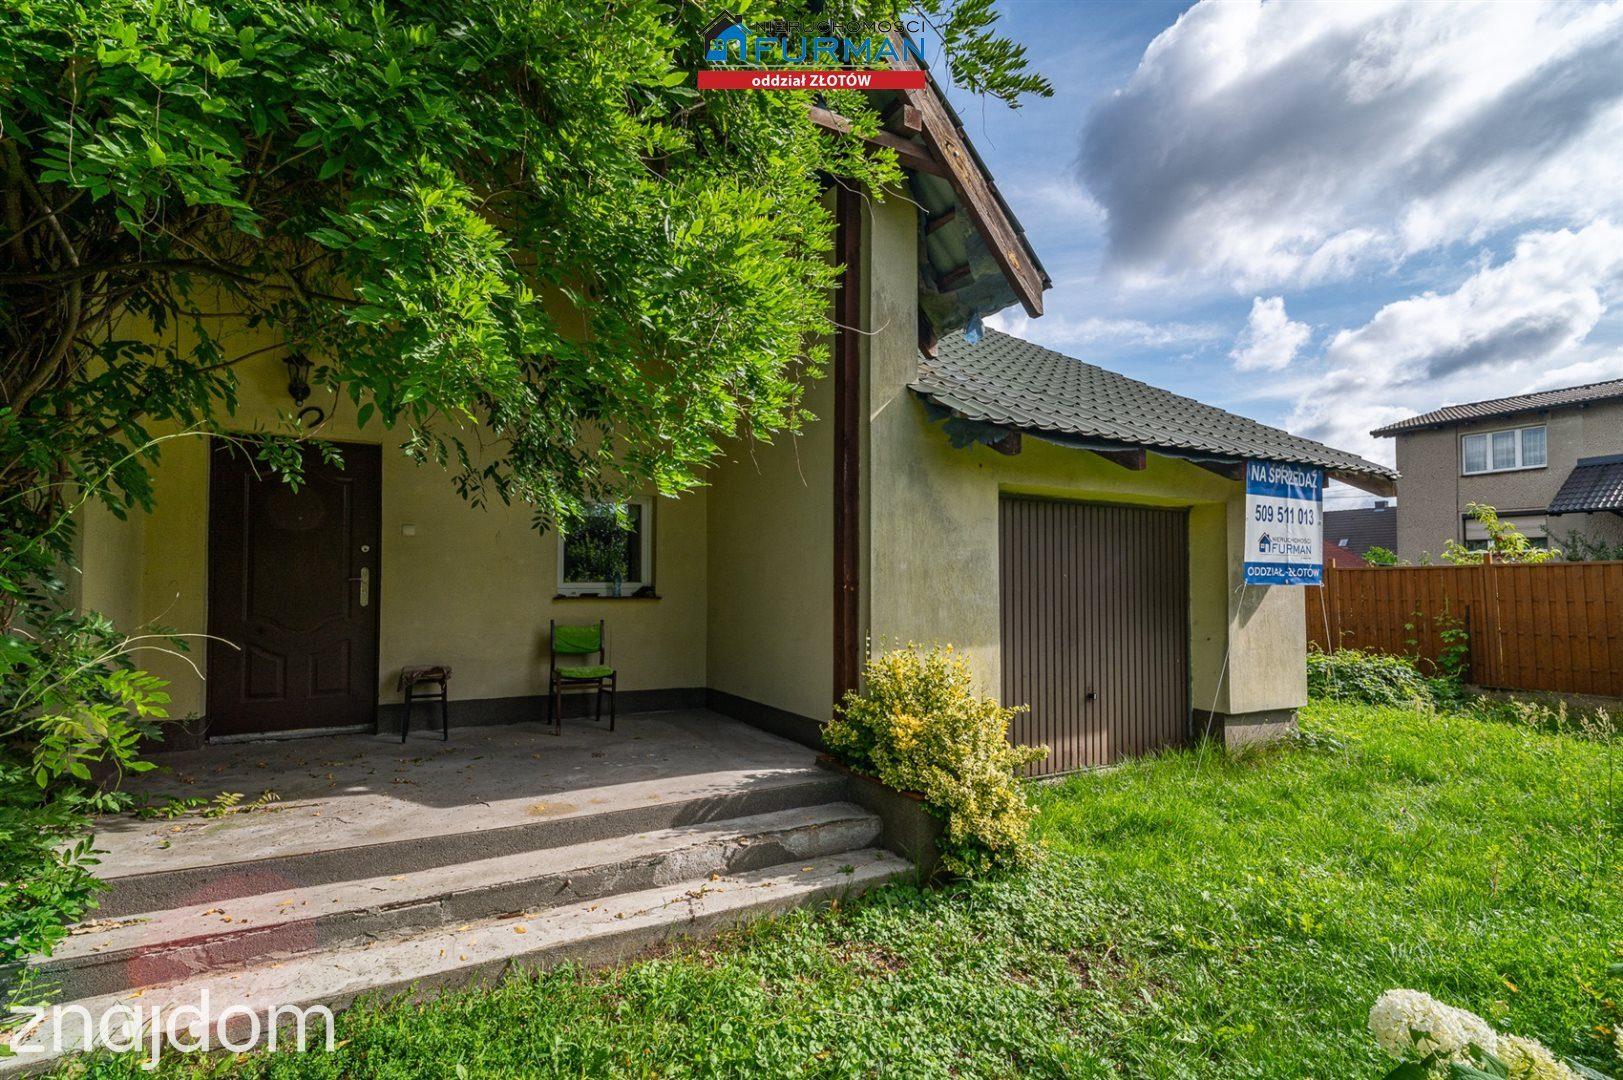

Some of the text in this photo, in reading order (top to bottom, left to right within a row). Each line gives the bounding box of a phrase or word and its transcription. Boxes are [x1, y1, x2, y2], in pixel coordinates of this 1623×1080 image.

[1251, 465, 1318, 488] NA SPRZEDAŻ
[1255, 504, 1314, 525] 509 511 013
[1272, 543, 1312, 554] FURMAN
[1247, 566, 1285, 577] ODDZIAŁ
